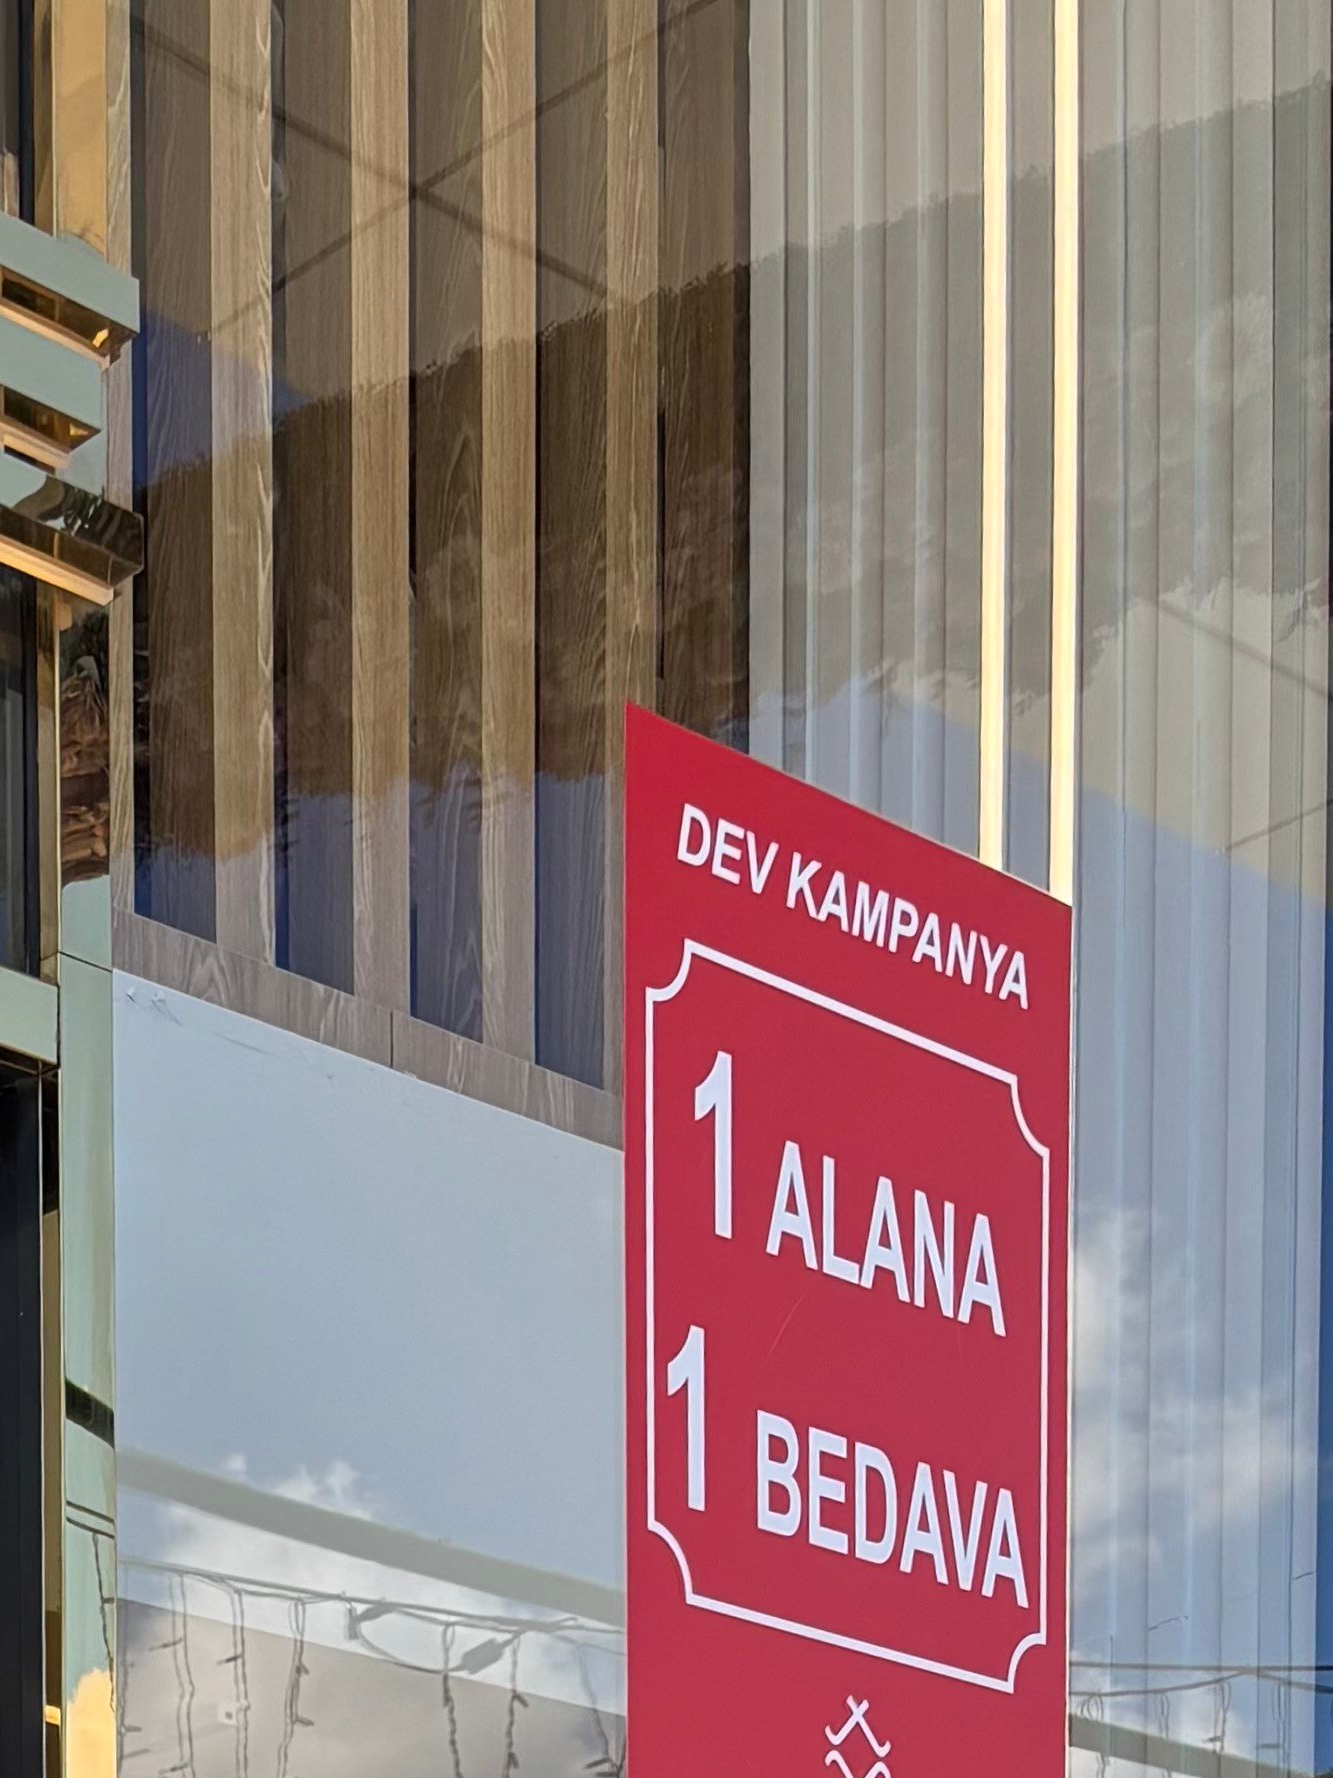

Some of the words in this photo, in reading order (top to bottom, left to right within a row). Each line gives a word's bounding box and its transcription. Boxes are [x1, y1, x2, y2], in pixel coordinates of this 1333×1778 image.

[676, 803, 780, 894] DEV
[785, 852, 1029, 1010] KAMPANYA
[693, 1050, 733, 1239] 1
[765, 1140, 1006, 1337] ALANA
[666, 1325, 706, 1512] 1
[756, 1409, 1030, 1610] BEDAVA
